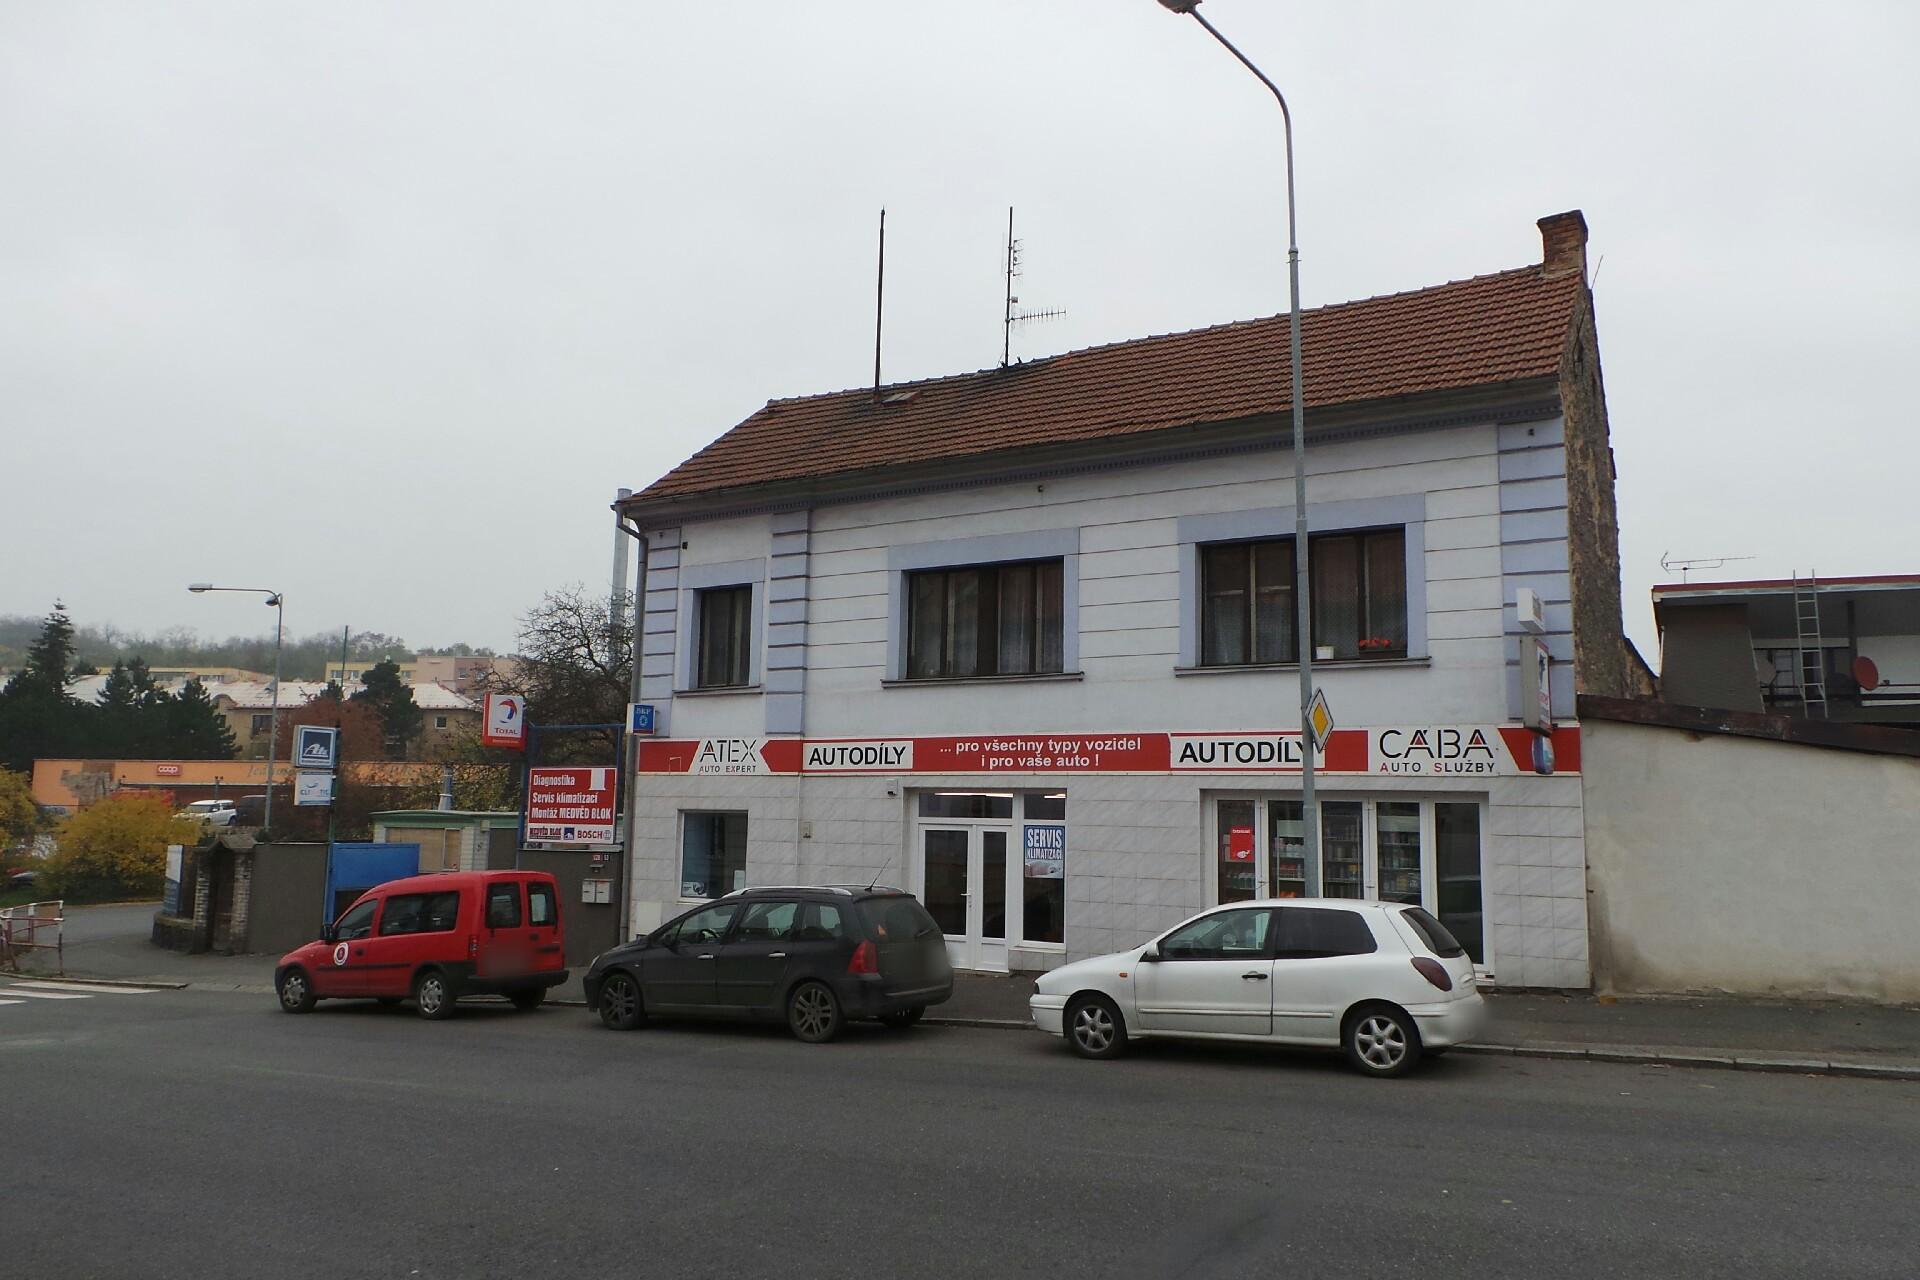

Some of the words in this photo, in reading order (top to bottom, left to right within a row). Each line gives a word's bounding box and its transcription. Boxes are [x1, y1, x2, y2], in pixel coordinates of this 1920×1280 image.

[494, 727, 519, 735] TOTAL
[699, 739, 757, 763] ATEX
[956, 742, 979, 755] pro
[984, 739, 1044, 754] všechny
[1048, 739, 1081, 754] typy
[1086, 737, 1141, 750] vozidel
[808, 742, 906, 766] AUTODÍLY
[699, 765, 721, 773] AUTO
[725, 765, 757, 773] EXPERT
[989, 757, 1014, 770] pro
[1018, 754, 1052, 767] vaše
[1056, 754, 1090, 767] auto
[1380, 763, 1421, 773] AUTO
[1434, 759, 1495, 773] SLUŽBY
[533, 774, 576, 787] Diagnostika
[532, 791, 555, 803] Servis
[556, 791, 598, 804] klimatizací
[531, 807, 558, 819] Montáž
[559, 805, 590, 819] MEDVĚD
[591, 808, 611, 819] BLOK
[577, 830, 603, 839] BOSCH
[1027, 828, 1063, 848] SERVIS
